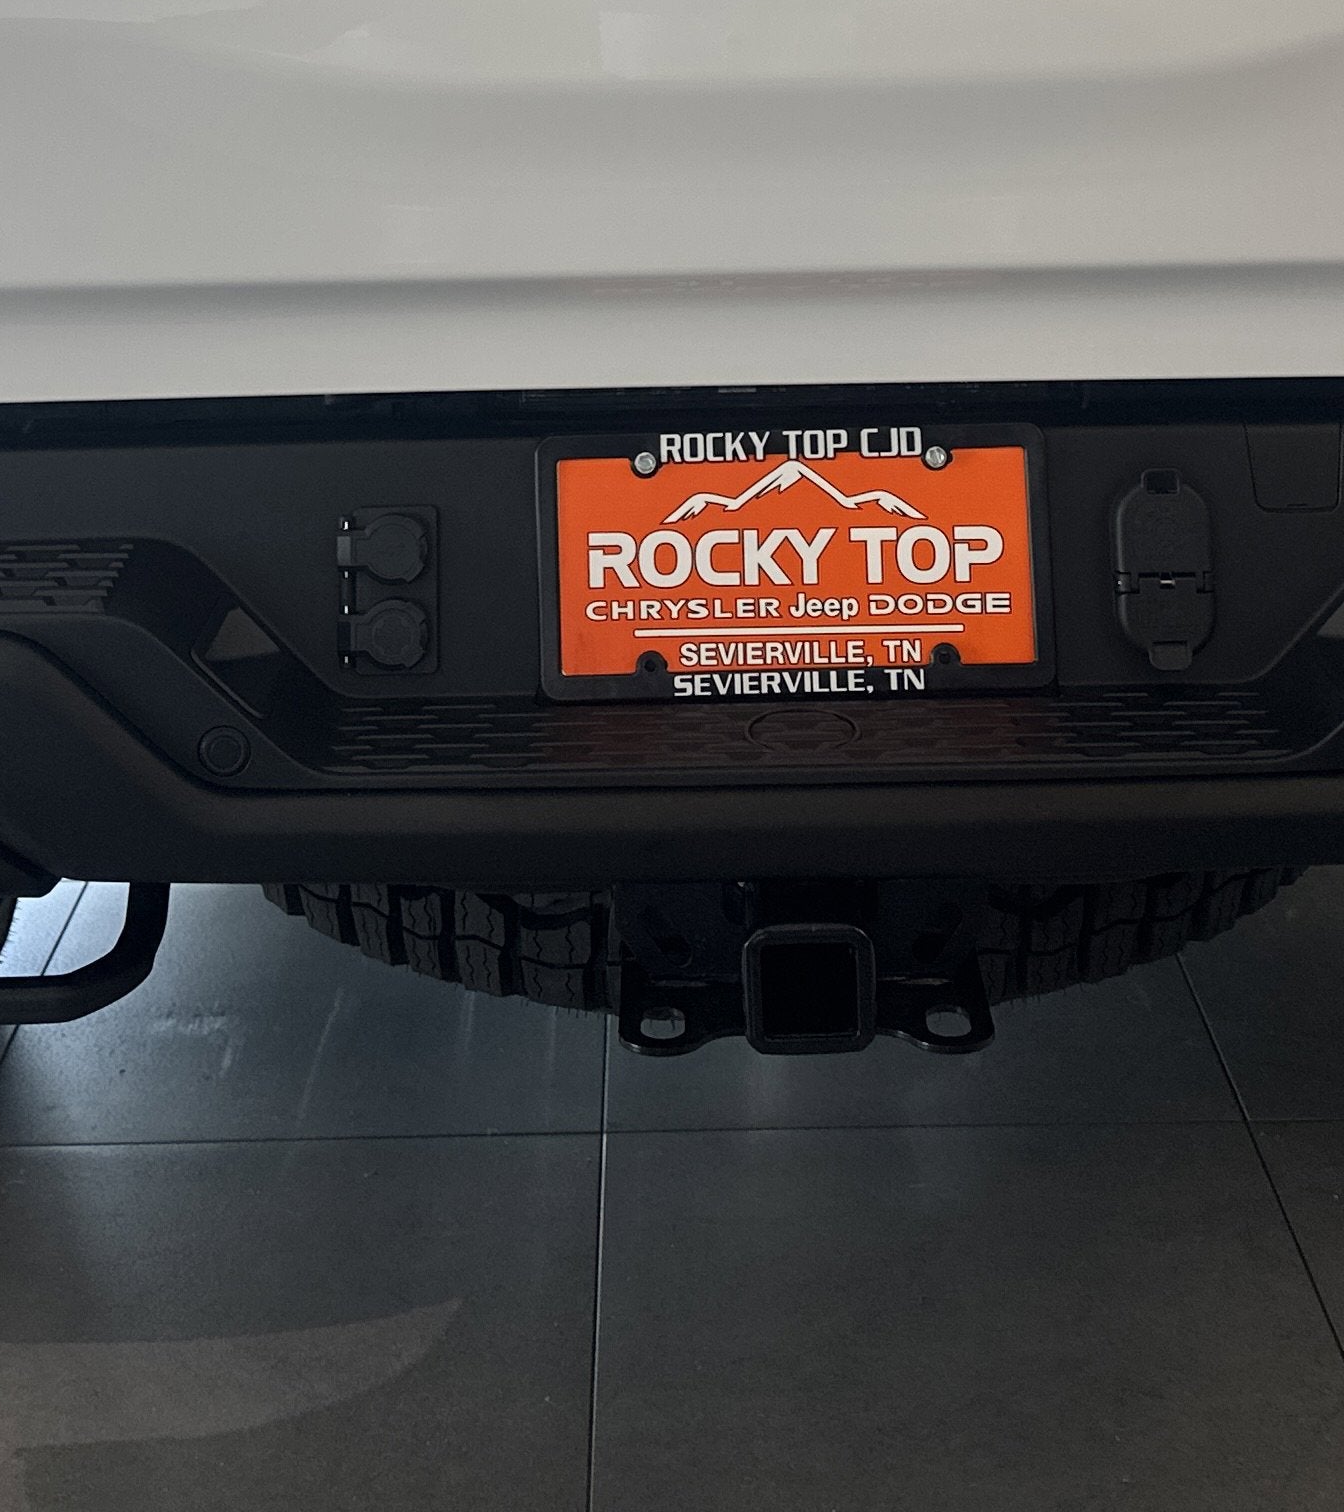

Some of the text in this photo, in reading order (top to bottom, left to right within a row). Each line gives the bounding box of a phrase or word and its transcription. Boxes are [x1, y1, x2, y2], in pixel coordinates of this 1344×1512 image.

[659, 426, 923, 463] ROCKY TOP CJD
[587, 524, 1005, 589] ROCKY TOP
[585, 592, 1012, 621] CHRYSLER Jeep DODGE
[679, 639, 922, 668] SEVIERVILLE, TN
[673, 668, 925, 697] SEVIERVILLE, TN
